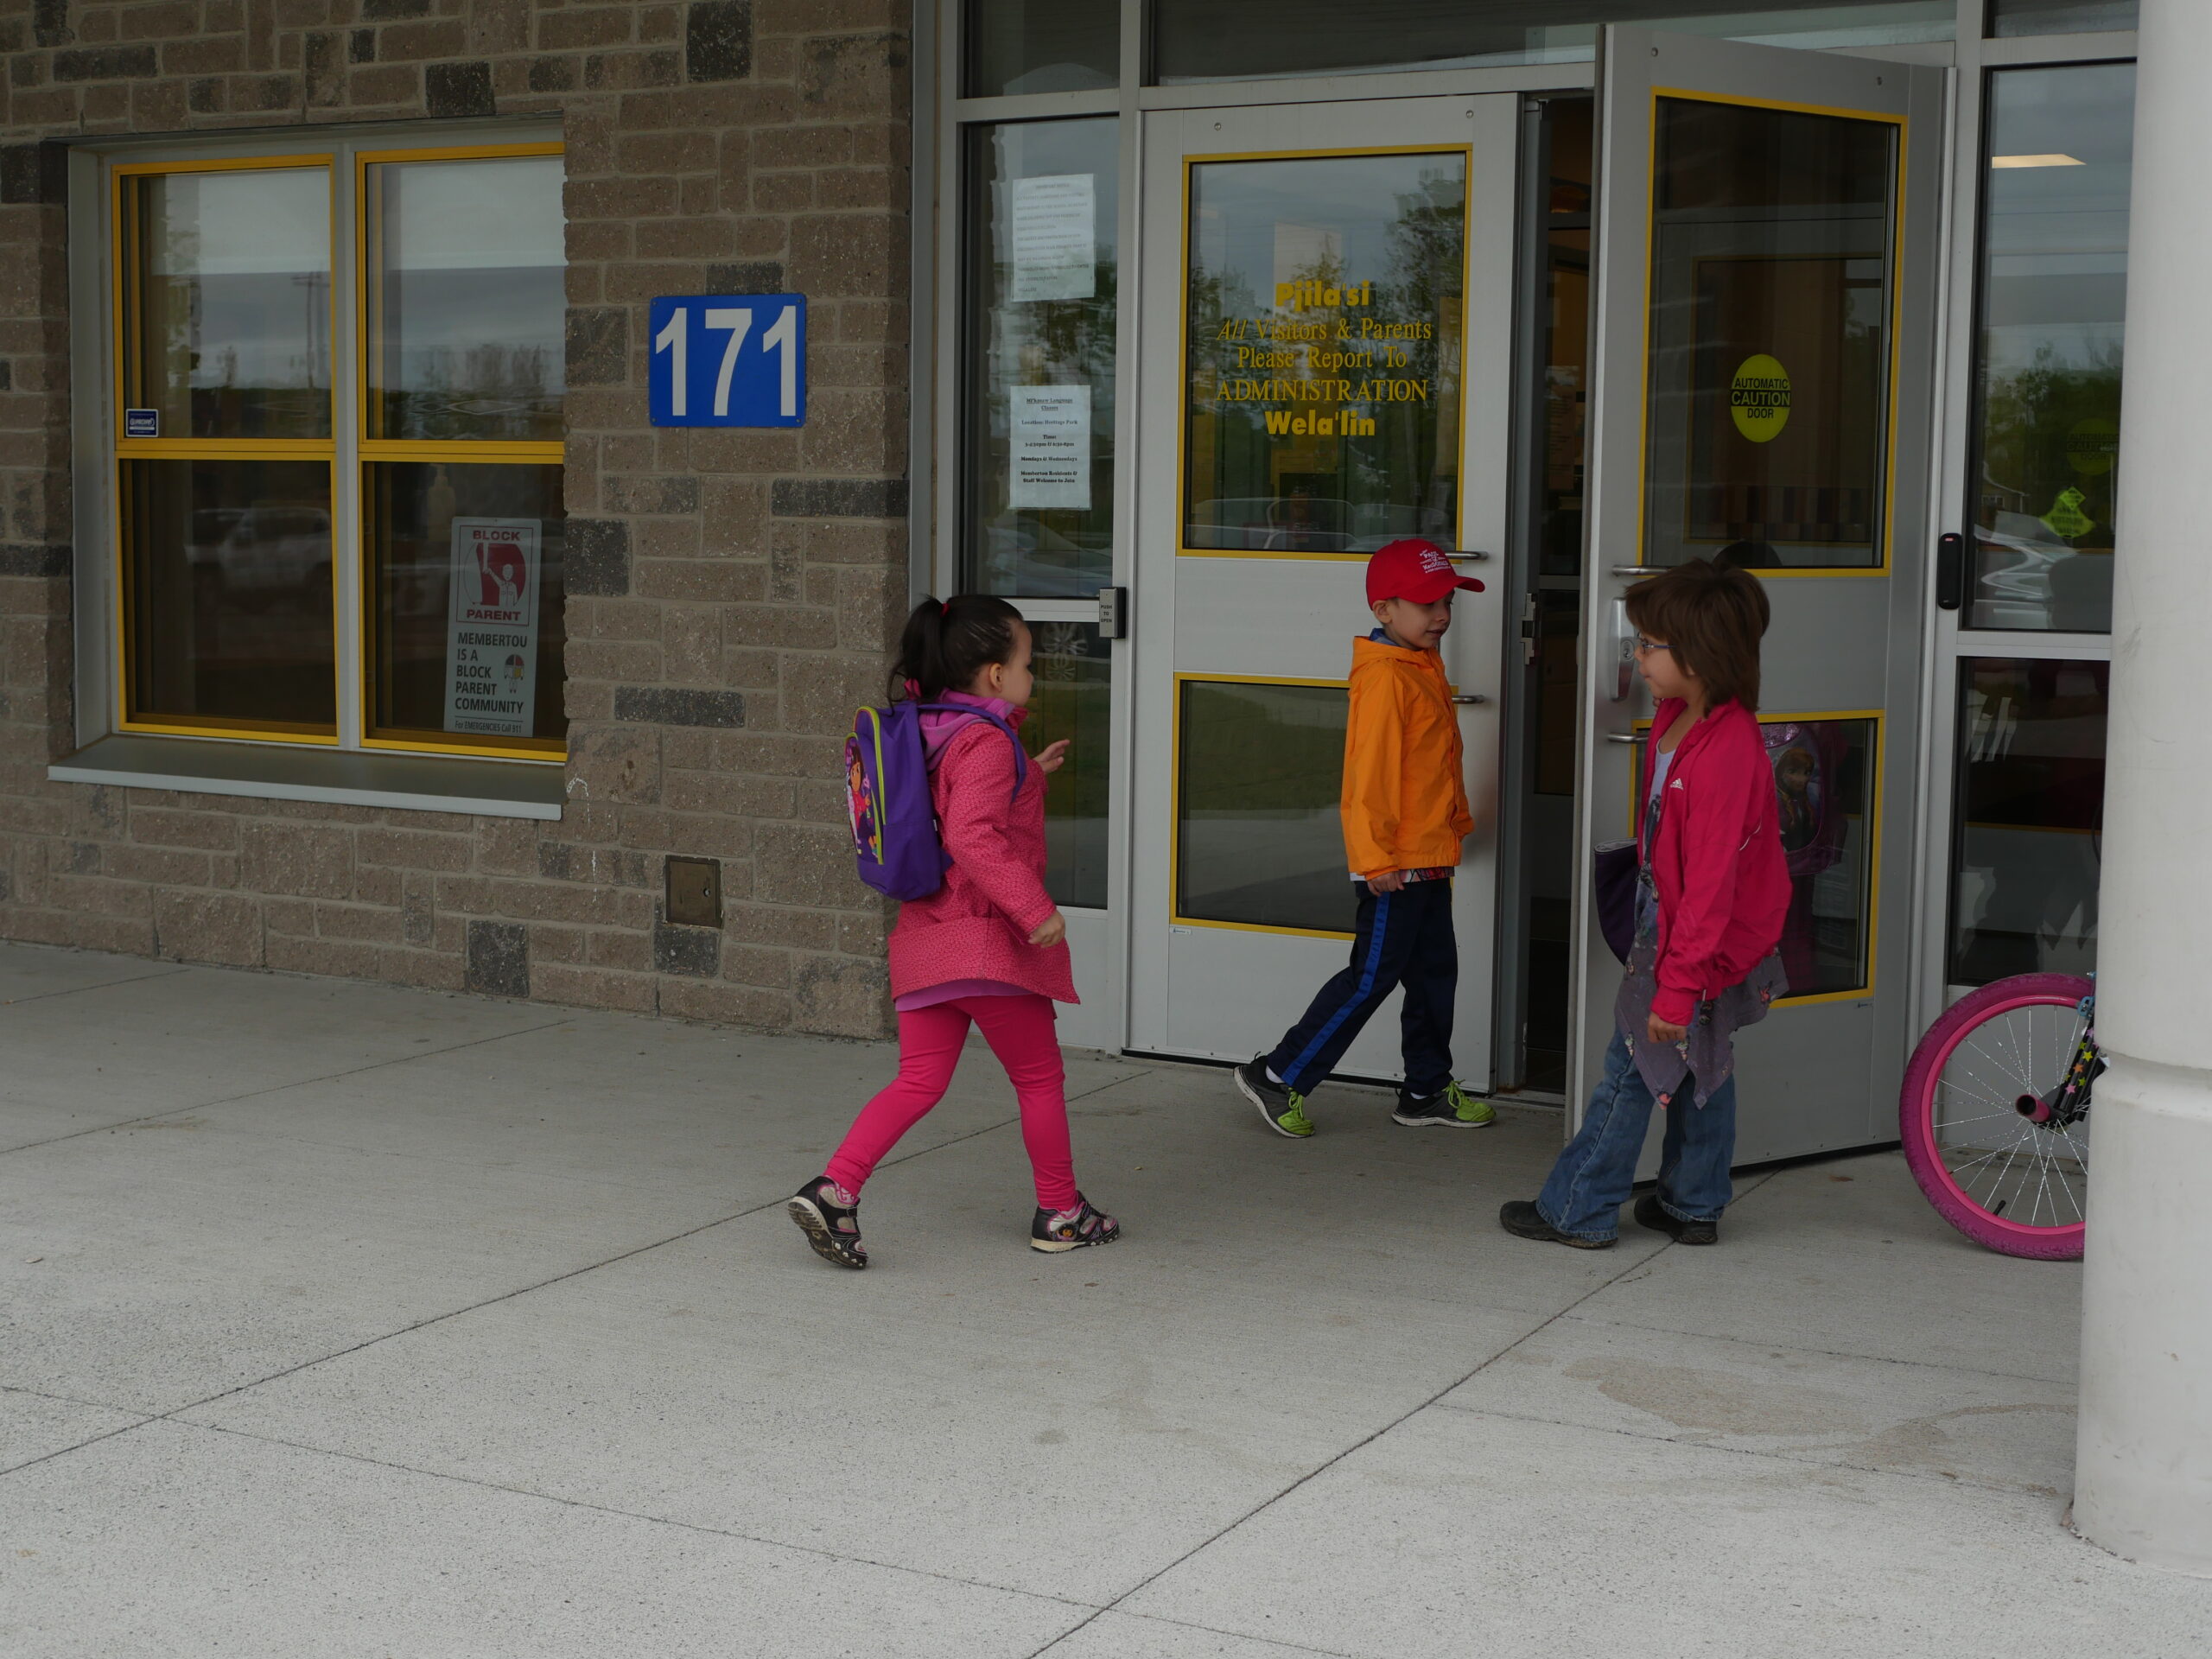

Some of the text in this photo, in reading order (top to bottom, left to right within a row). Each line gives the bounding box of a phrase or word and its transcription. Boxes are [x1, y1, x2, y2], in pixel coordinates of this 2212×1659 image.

[1274, 280, 1370, 312] Pjila'si
[1216, 317, 1432, 340] All Visitors & Parents
[655, 305, 797, 416] 171
[1236, 346, 1407, 373] Please Report To
[1216, 379, 1429, 401] ADMINISTRATION
[1734, 378, 1789, 389] AUTOMATIC
[1731, 391, 1790, 406] CAUTION
[1747, 408, 1774, 419] DOOR
[1264, 409, 1376, 436] Wela'lin
[473, 530, 521, 541] BLOCK
[467, 609, 522, 621] PARENT
[457, 632, 528, 647] MEMBERTOU
[457, 649, 478, 662] IS A
[456, 664, 492, 679] BLOCK
[455, 681, 498, 696] PARENT
[455, 697, 524, 714] COMMUNITY
[464, 721, 500, 732] EMERGENCIES
[501, 724, 512, 733] Call
[512, 724, 522, 734] 911
